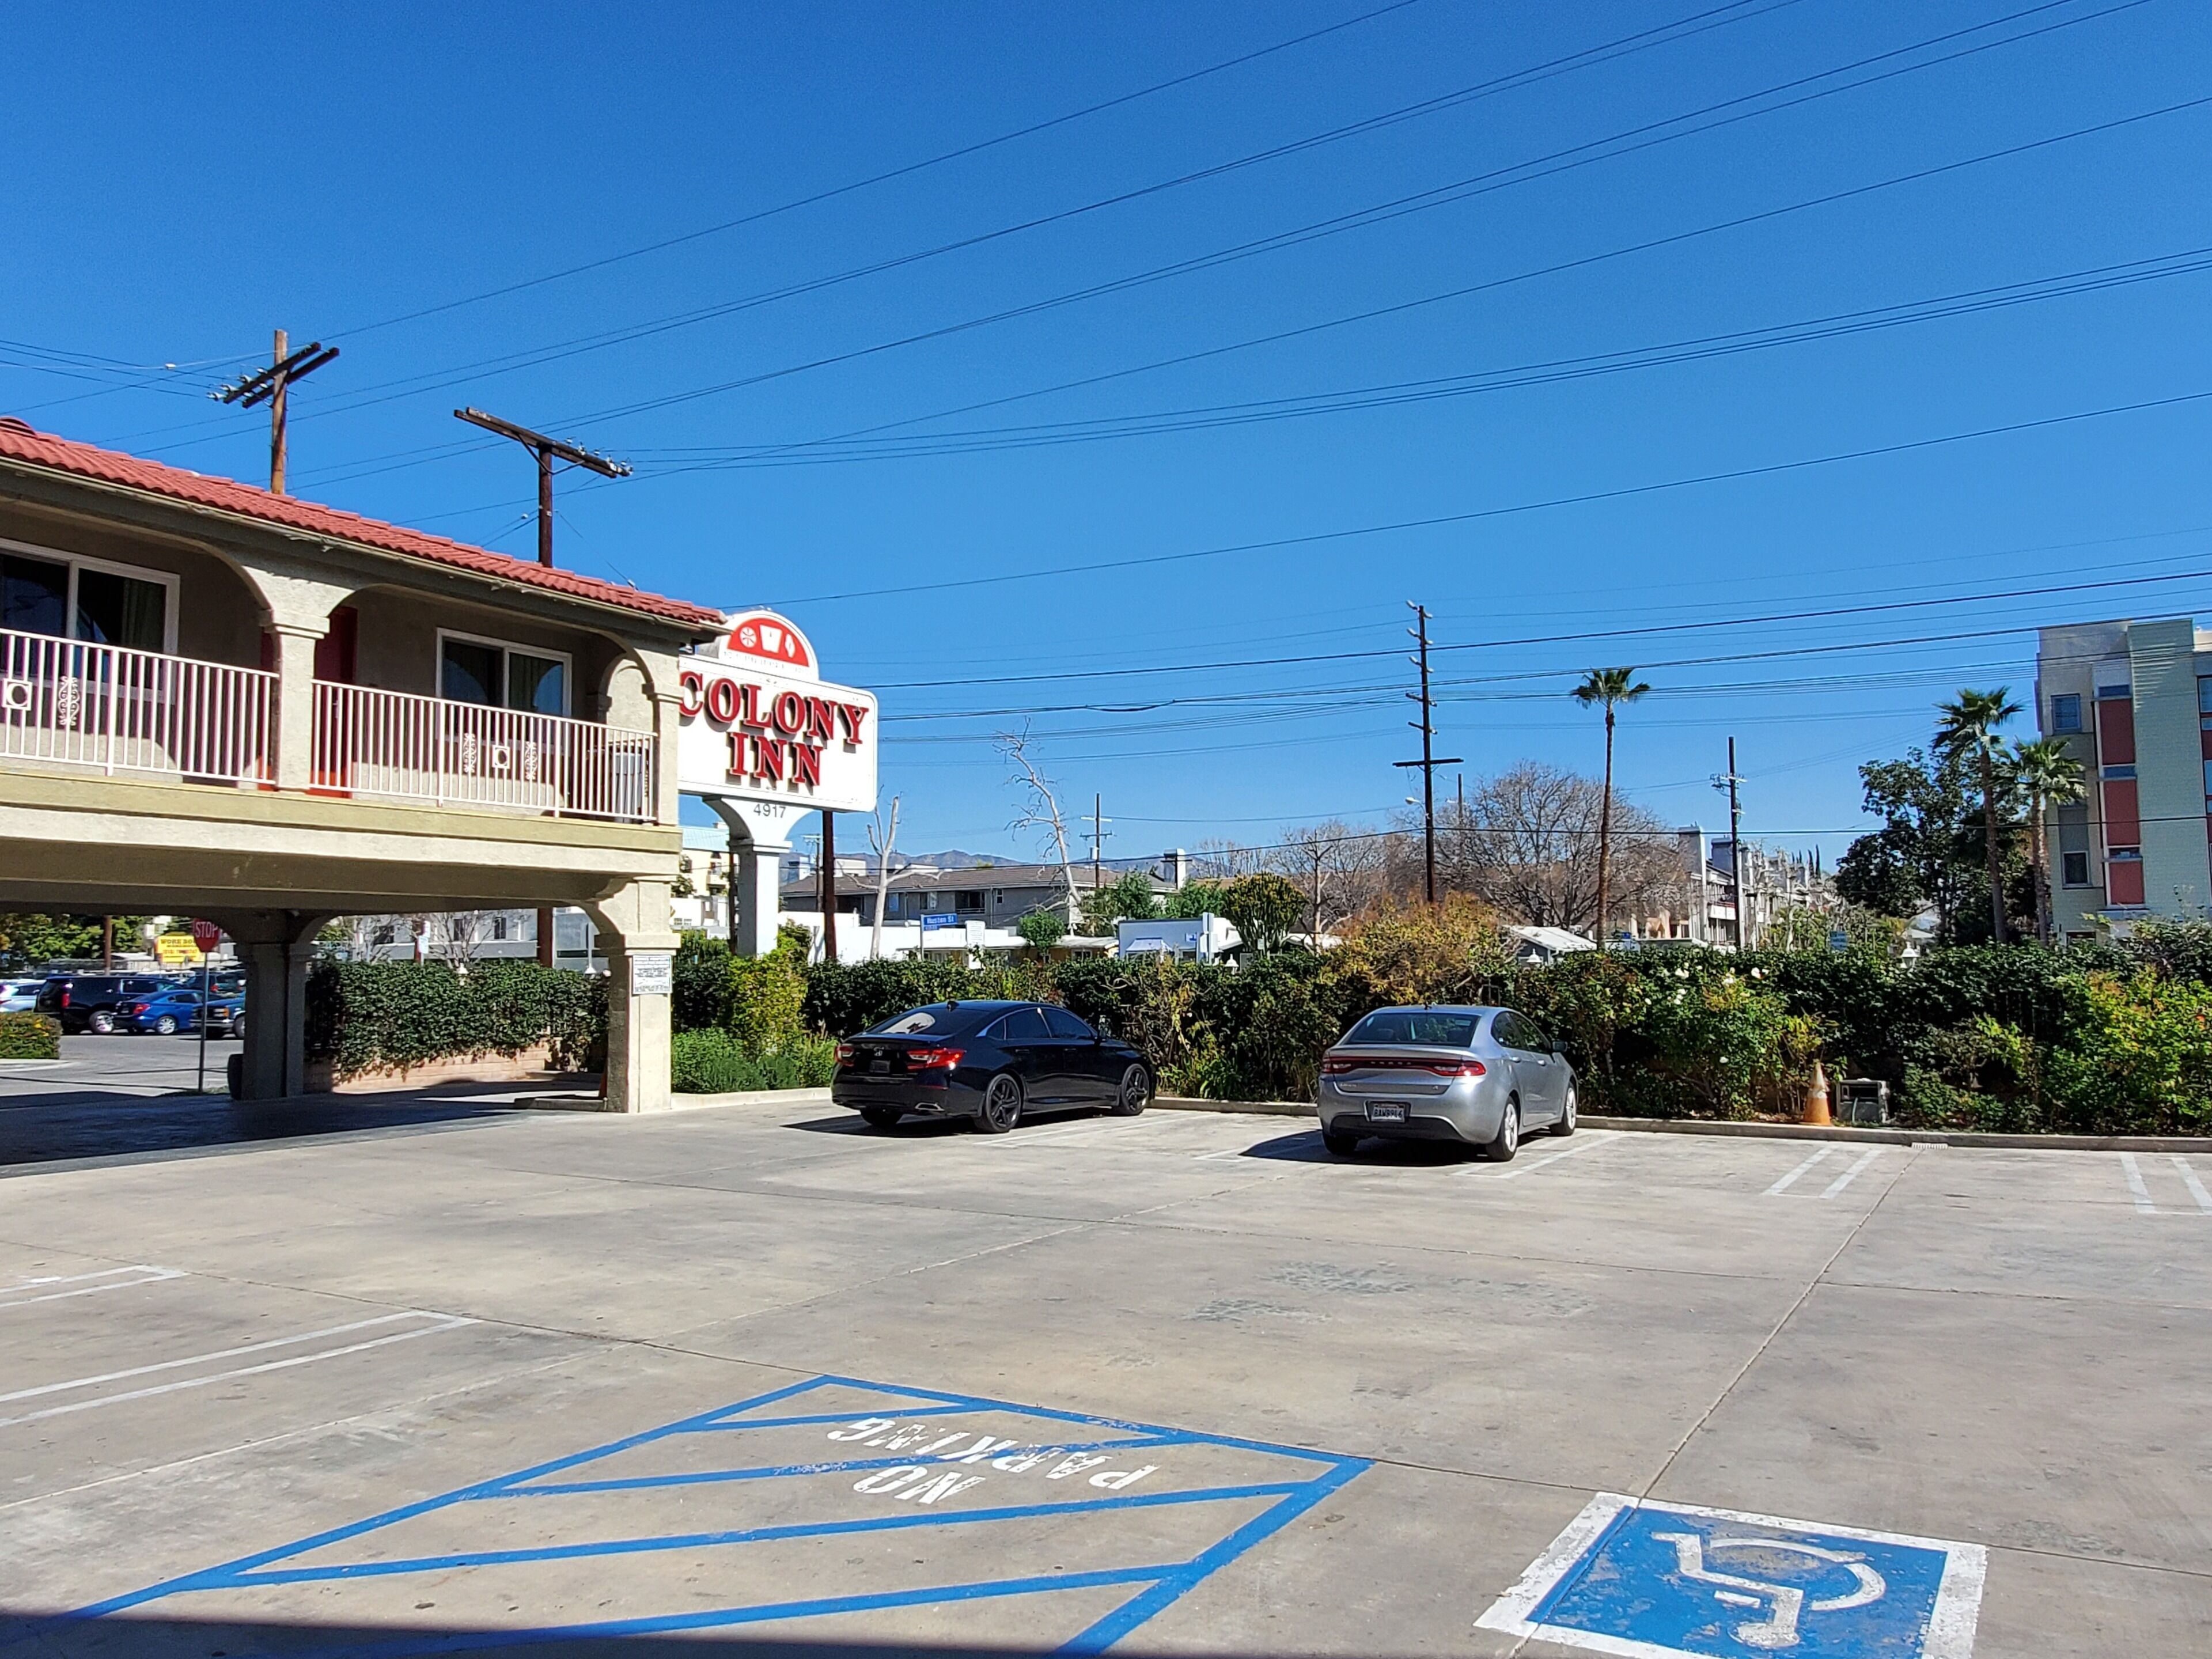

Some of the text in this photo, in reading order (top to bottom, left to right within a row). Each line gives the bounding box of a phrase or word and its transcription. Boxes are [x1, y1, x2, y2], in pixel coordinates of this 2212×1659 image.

[679, 671, 869, 745] COLONY
[729, 732, 824, 787] INN
[753, 803, 787, 819] 4917
[196, 921, 219, 938] STOP
[827, 1417, 1160, 1490] PARKING
[853, 1465, 986, 1505] NO
